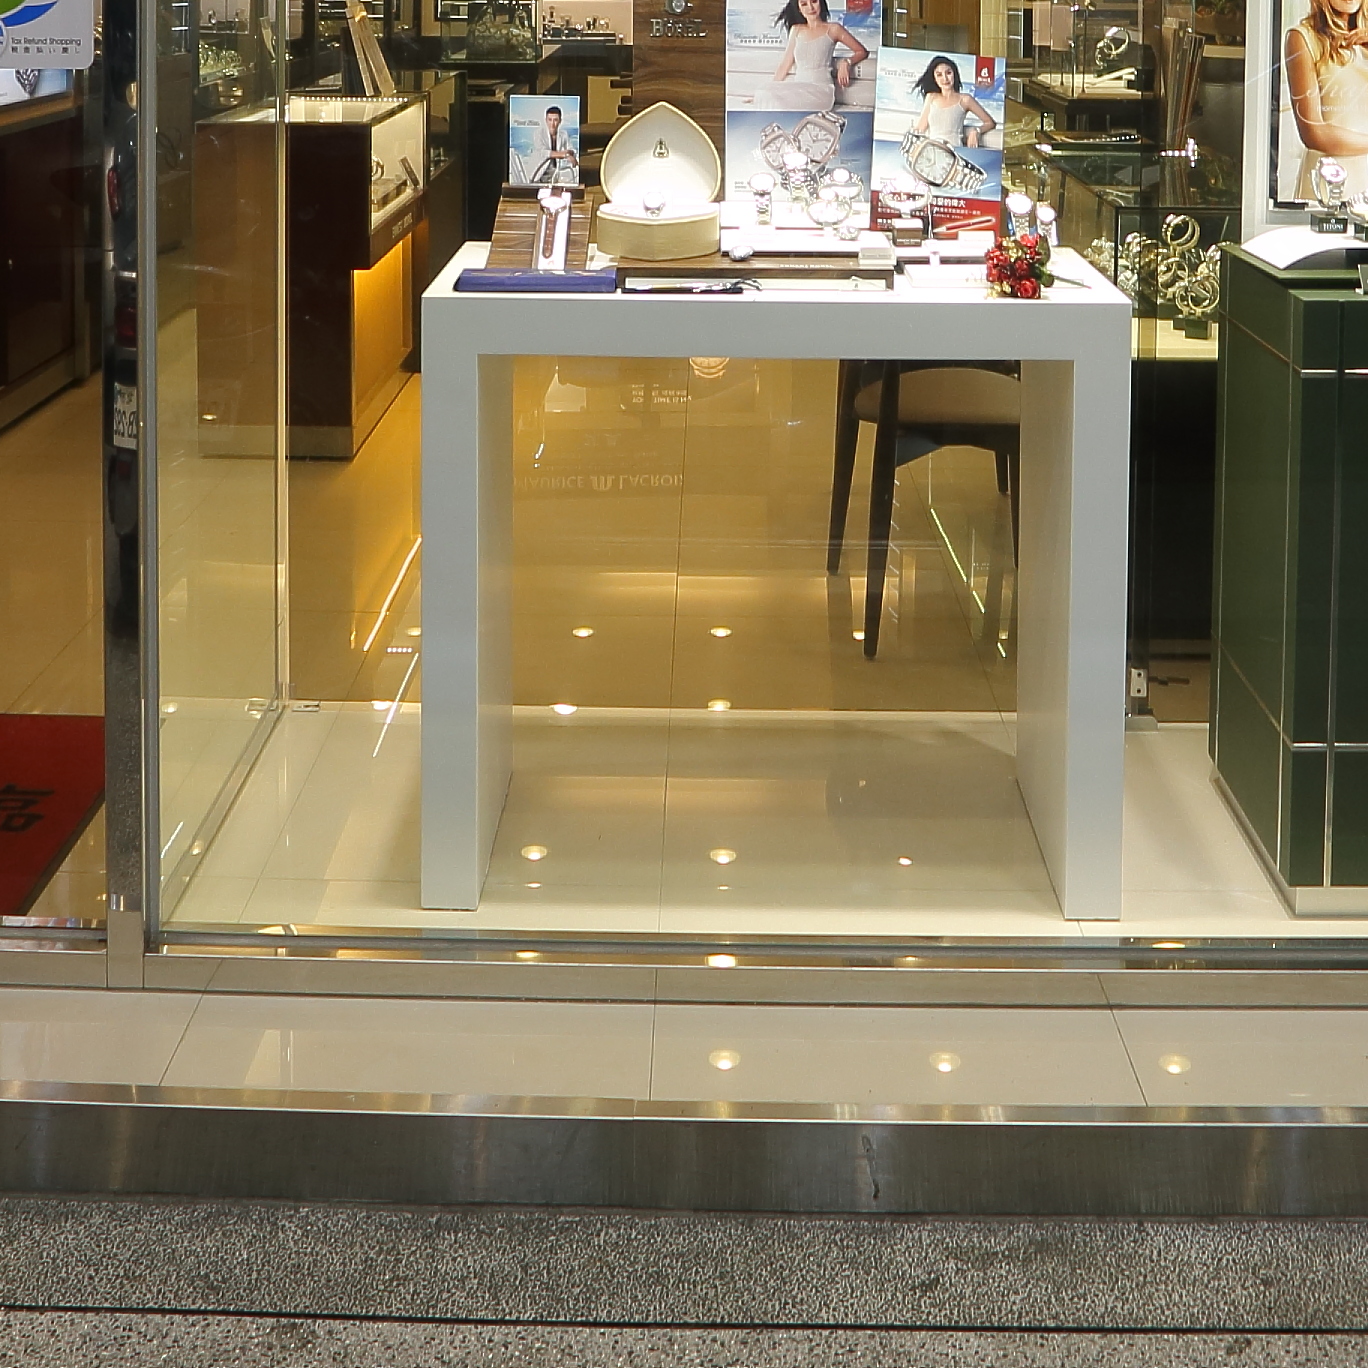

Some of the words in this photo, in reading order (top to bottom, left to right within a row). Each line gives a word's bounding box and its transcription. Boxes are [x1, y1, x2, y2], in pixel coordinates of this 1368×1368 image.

[11, 37, 22, 45] Tax
[23, 37, 47, 45] Refund
[49, 37, 81, 46] Shopping
